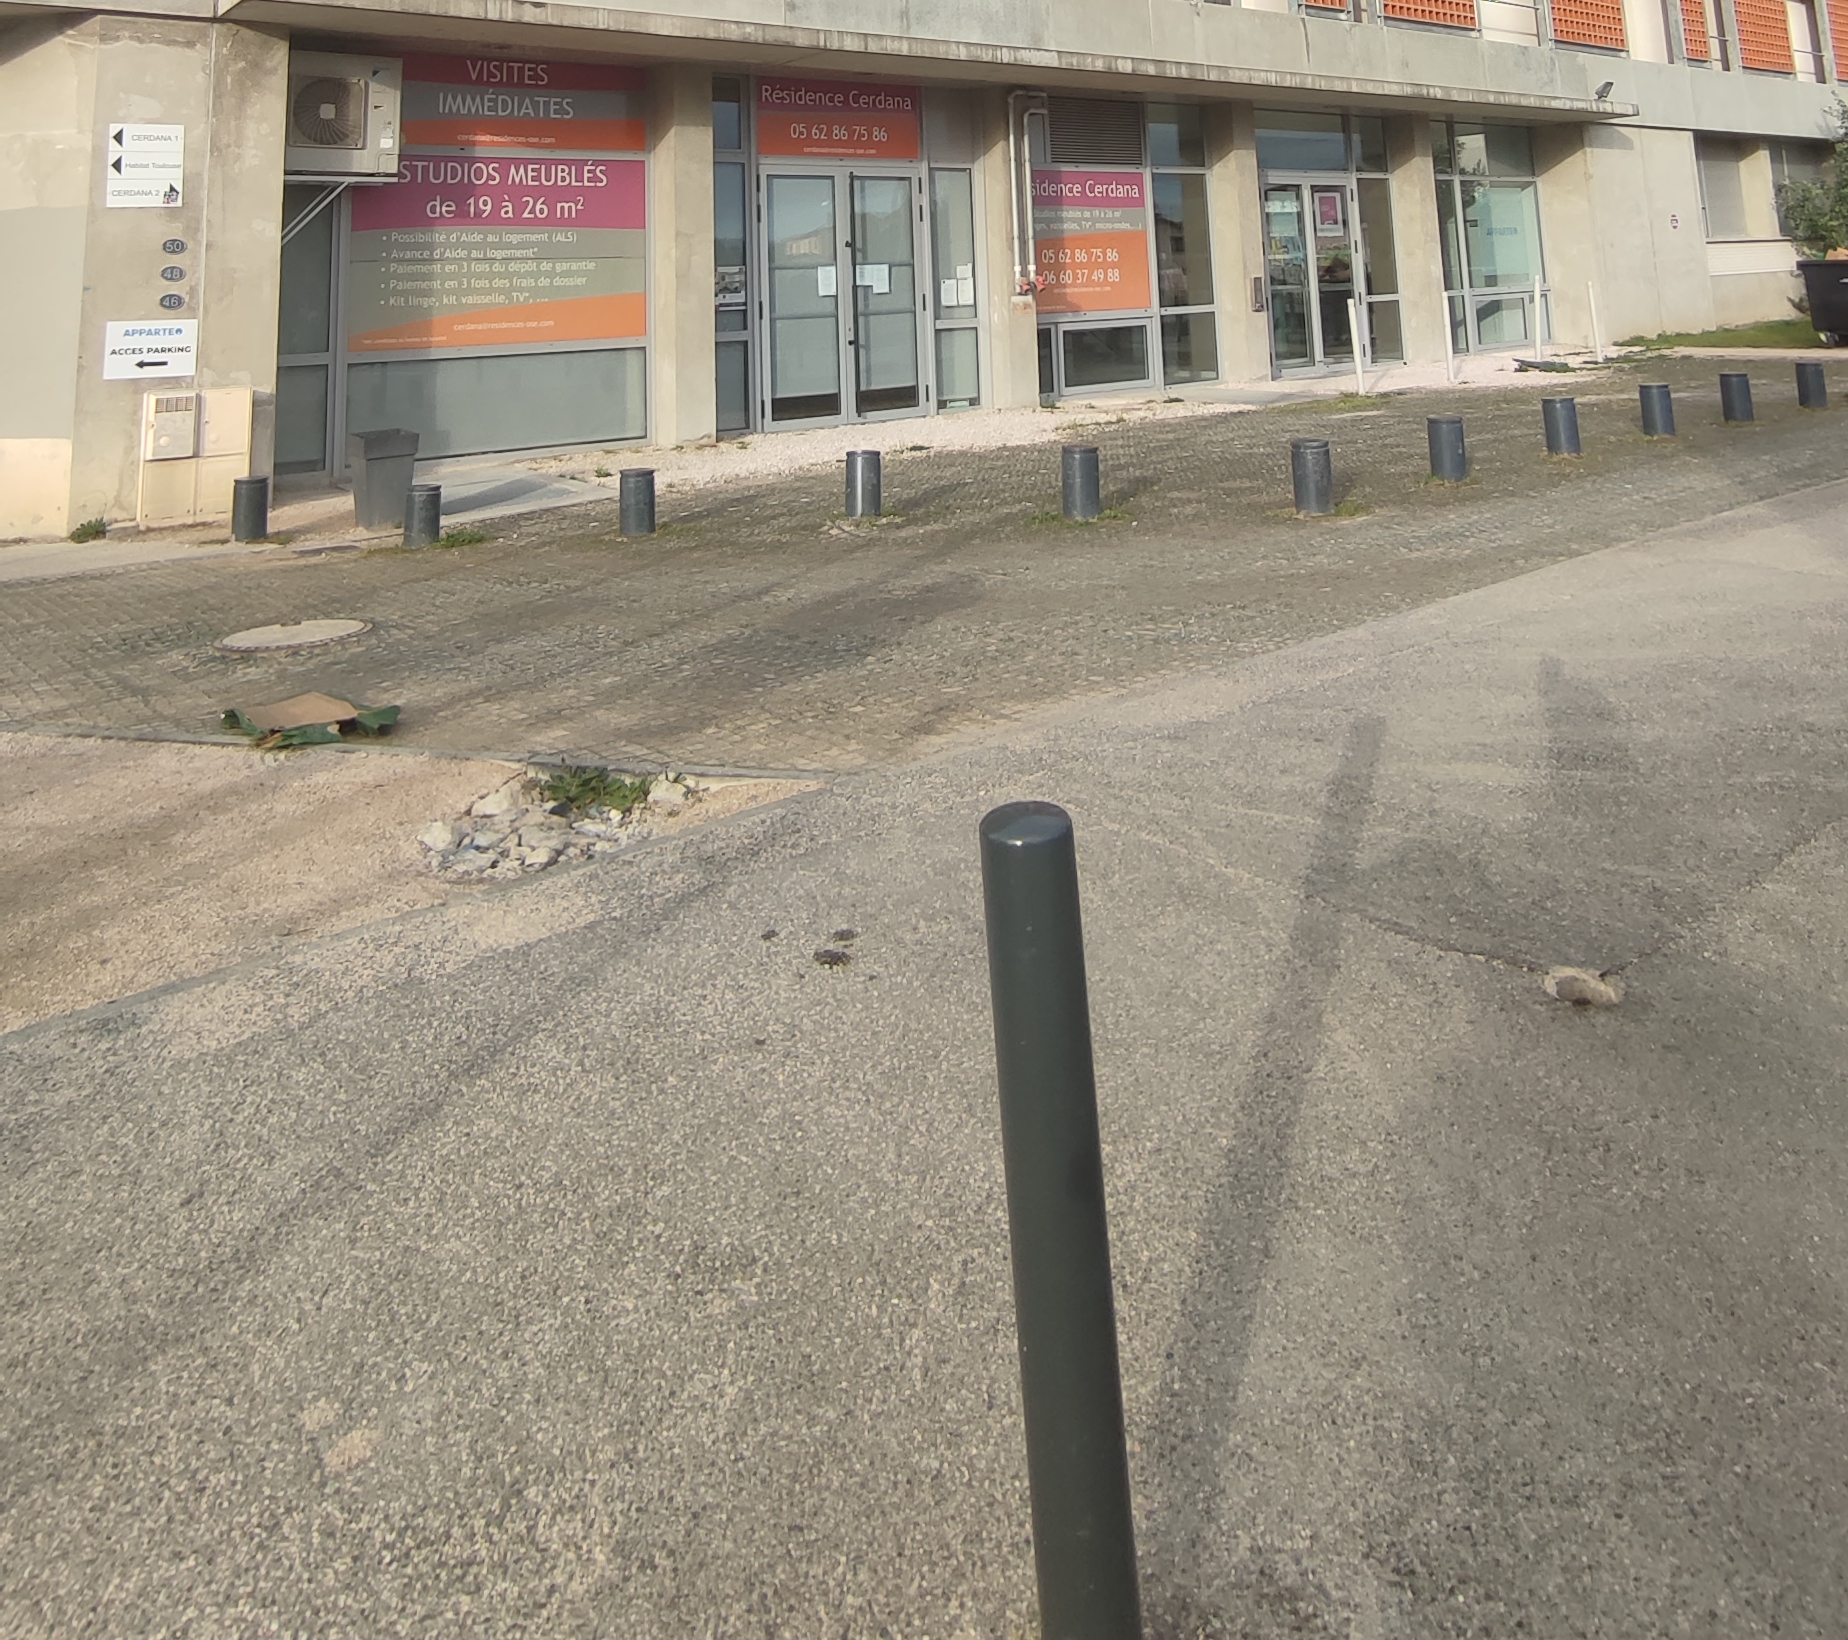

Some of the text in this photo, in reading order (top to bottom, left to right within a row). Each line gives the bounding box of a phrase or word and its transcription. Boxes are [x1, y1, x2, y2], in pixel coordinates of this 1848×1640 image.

[466, 60, 548, 84] VISITES
[439, 89, 574, 118] IMMÉDIATES
[761, 84, 912, 110] Résidence Cerdana
[790, 123, 888, 142] 05 62 86 75 86
[399, 160, 608, 187] STUDIOS MEUBLÉS
[1031, 179, 1139, 198] sidence Cerdana
[426, 195, 456, 218] de
[466, 197, 492, 218] 19
[500, 194, 514, 218] à
[521, 197, 548, 218] 26
[391, 231, 577, 244] Possibilité d'Aide au logement (ALS)
[165, 241, 182, 252] 50
[391, 249, 430, 259] Avance
[433, 247, 468, 258] d'Aide
[471, 250, 484, 258] au
[1041, 248, 1119, 264] 05 62 86 75 86
[163, 268, 180, 279] 48
[389, 263, 441, 274] Paiement
[461, 262, 468, 272] 3
[471, 261, 490, 272] fois
[492, 261, 505, 272] du
[508, 260, 537, 273] dépôt
[540, 261, 553, 271] de
[555, 260, 596, 273] garantie
[389, 275, 587, 290] Paiement en 3 fois des frais de dossier
[1043, 268, 1120, 285] 06 60 37 49 88
[162, 296, 179, 307] 46
[389, 296, 405, 307] Kit
[408, 295, 440, 308] linge,
[442, 294, 458, 305] kit
[461, 293, 509, 305] vaisselle,
[109, 346, 192, 356] ACCES PARKING
